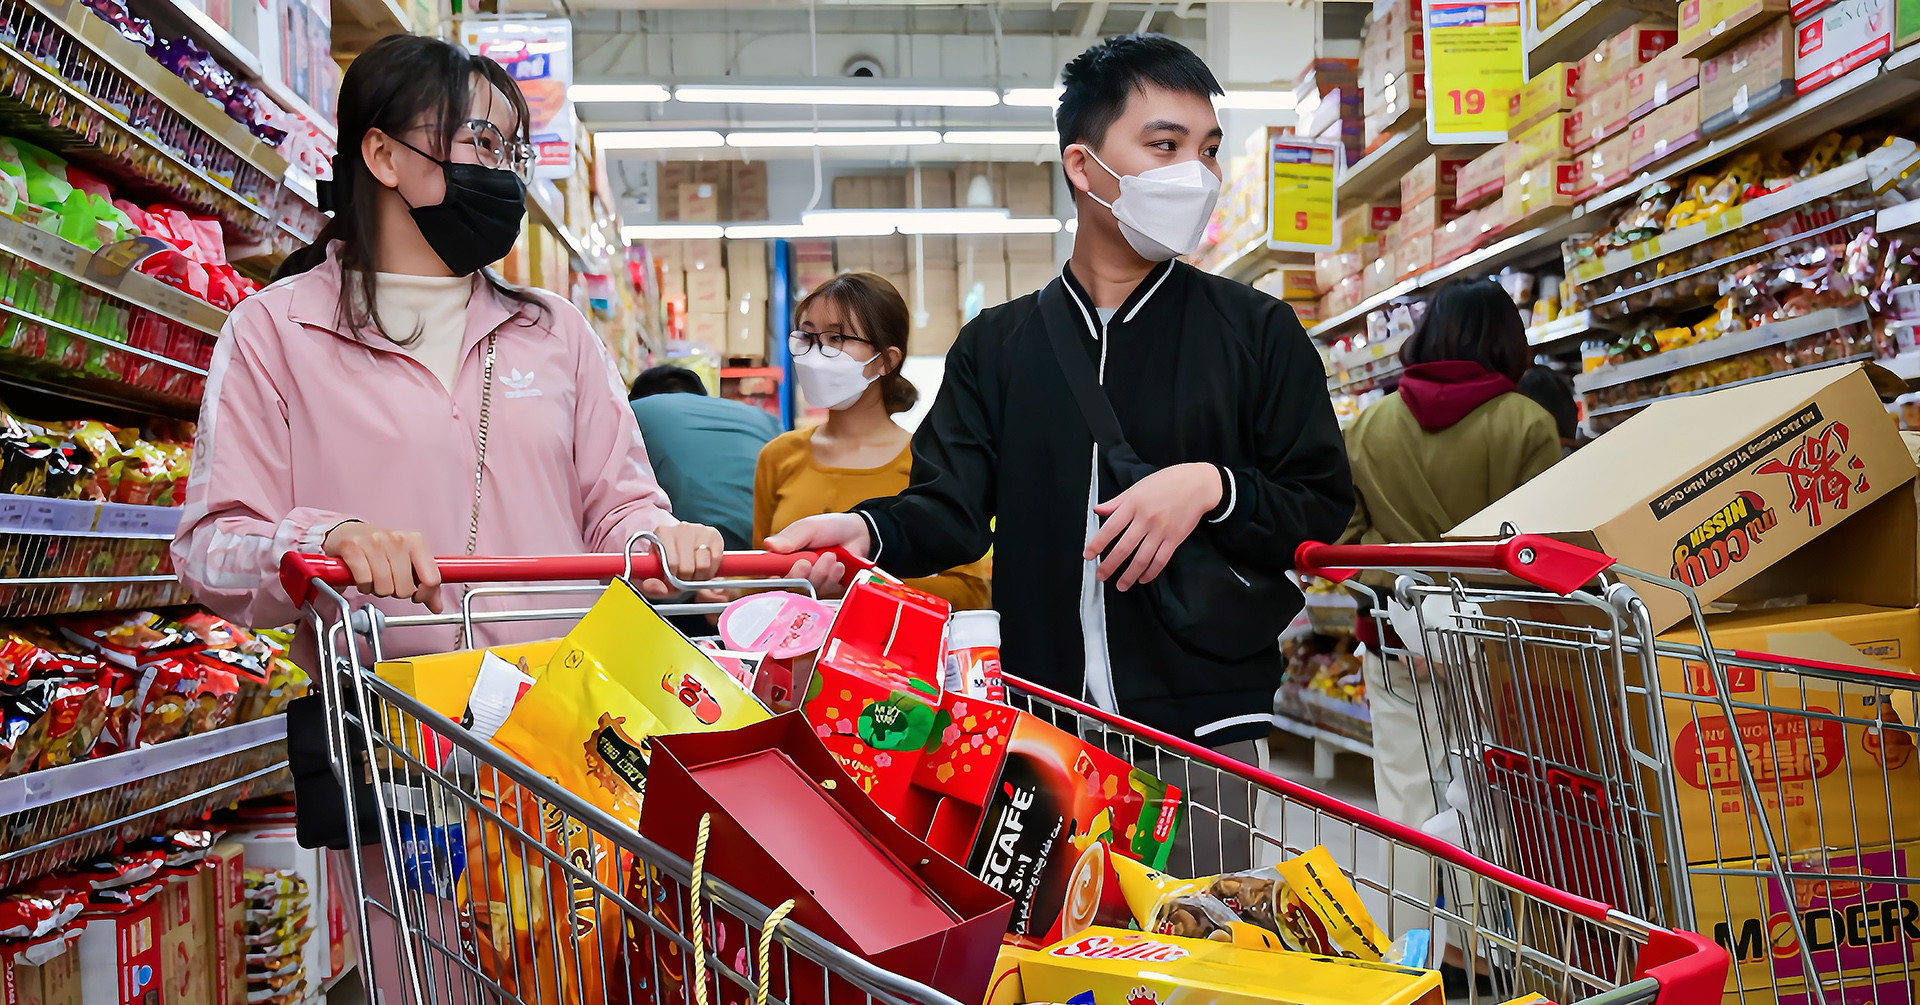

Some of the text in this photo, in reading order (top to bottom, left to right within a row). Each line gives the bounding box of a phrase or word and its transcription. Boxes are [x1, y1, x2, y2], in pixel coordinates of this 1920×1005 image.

[1448, 89, 1486, 115] 19
[1690, 497, 1747, 547] NISSIN
[1734, 671, 1745, 686] 7
